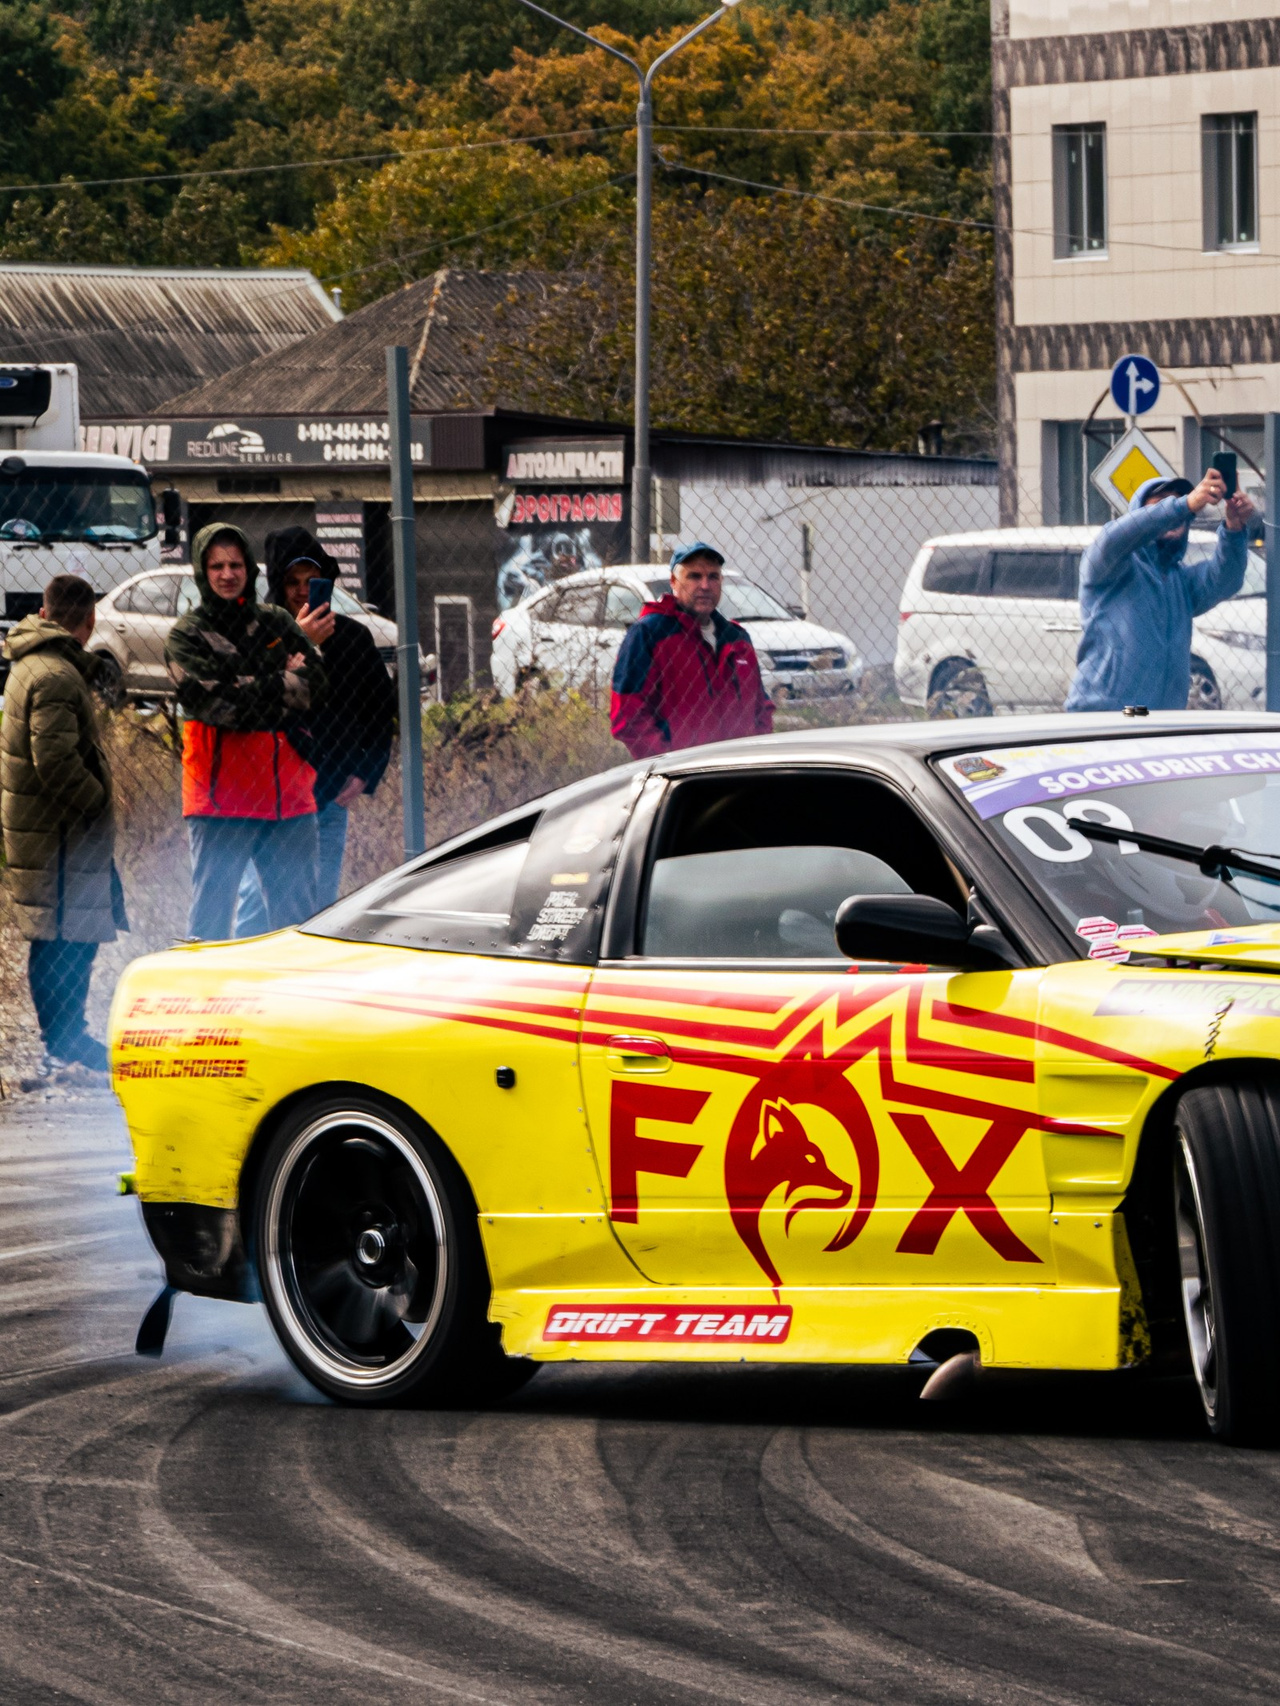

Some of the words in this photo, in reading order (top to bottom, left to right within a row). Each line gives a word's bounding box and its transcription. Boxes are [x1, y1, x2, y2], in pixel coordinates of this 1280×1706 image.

[186, 440, 240, 458] REDLINE
[239, 452, 293, 464] SERVICE
[506, 451, 624, 479] АВТОЗАПЧАСТИ
[511, 493, 622, 523] ЭРОГРАФИЯ
[1037, 763, 1143, 795] SOCHI
[1141, 754, 1229, 780] DRIFT
[609, 1062, 1044, 1286] FOX
[546, 1311, 666, 1335] DRIFT
[674, 1313, 790, 1337] TEAM
